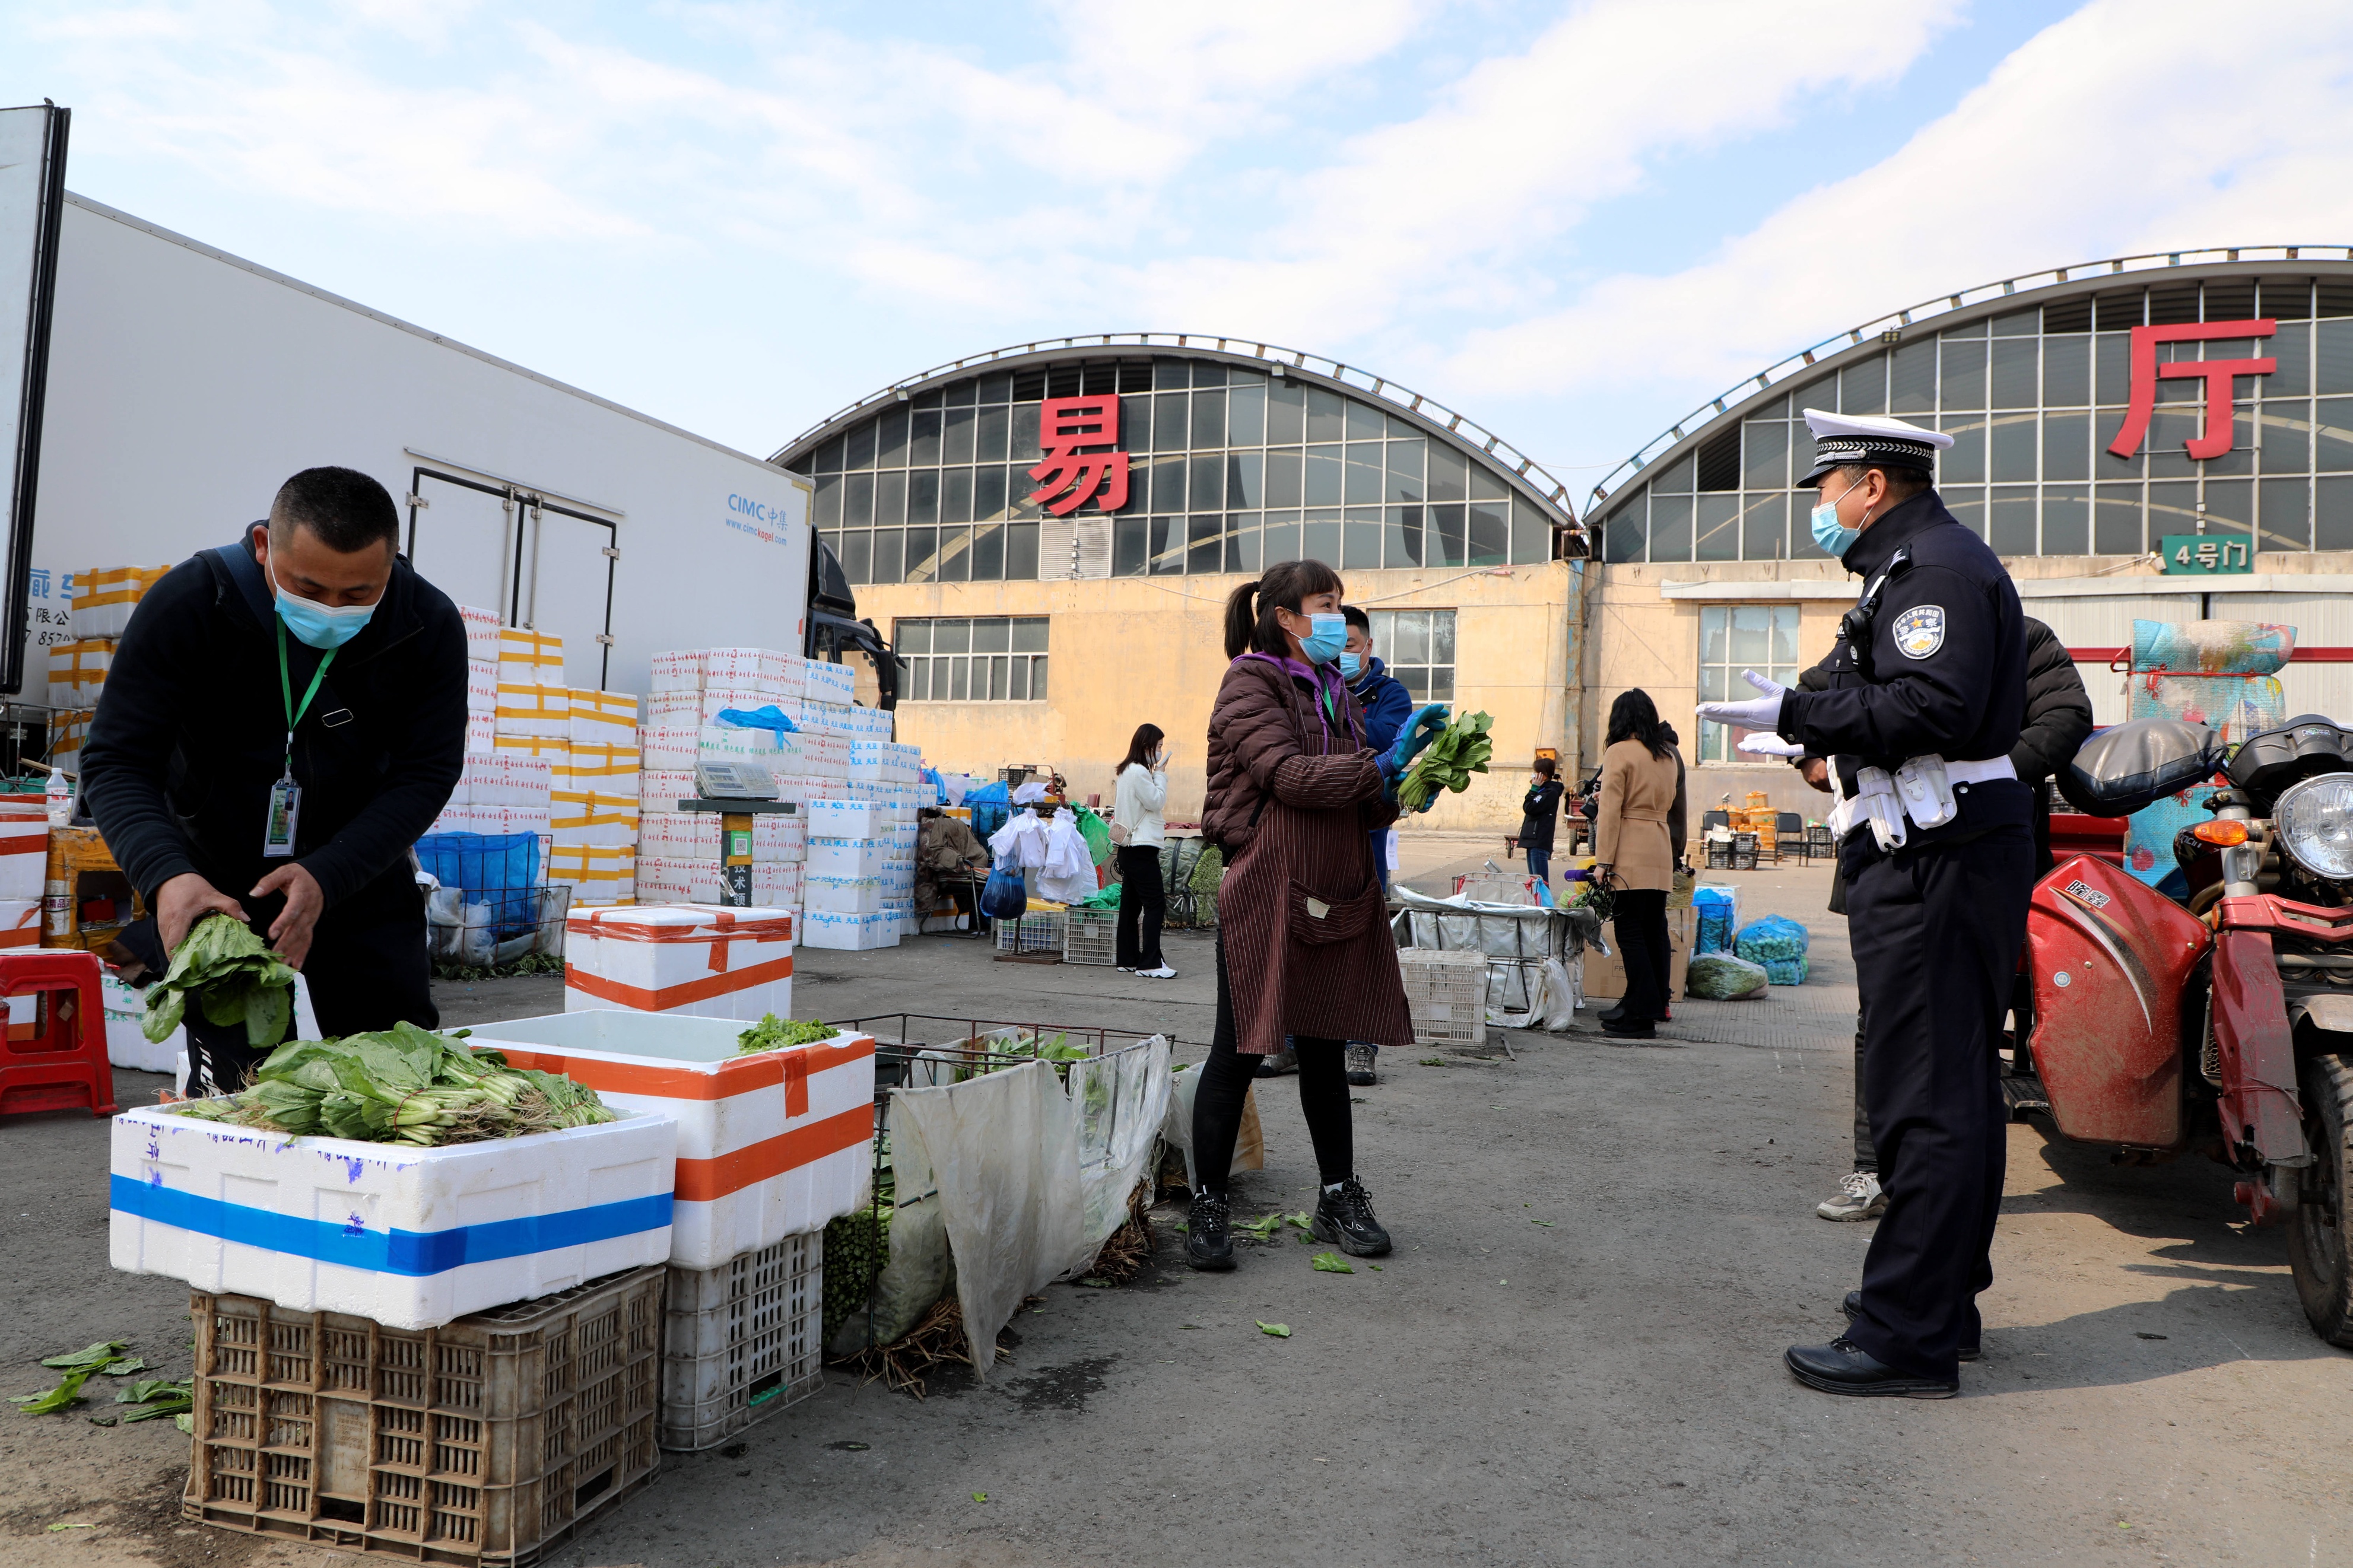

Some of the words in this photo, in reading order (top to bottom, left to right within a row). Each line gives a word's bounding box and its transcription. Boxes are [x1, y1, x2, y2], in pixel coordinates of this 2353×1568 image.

[2107, 318, 2277, 460] 厅
[1027, 394, 1129, 517] 易
[728, 494, 766, 521] CIMC
[767, 507, 788, 532] 中集
[726, 518, 787, 546] www.cimckogel.com
[2175, 540, 2247, 569] 4号门
[1896, 609, 1940, 628] 中华人民共和国
[2066, 880, 2110, 908] 隆鑫
